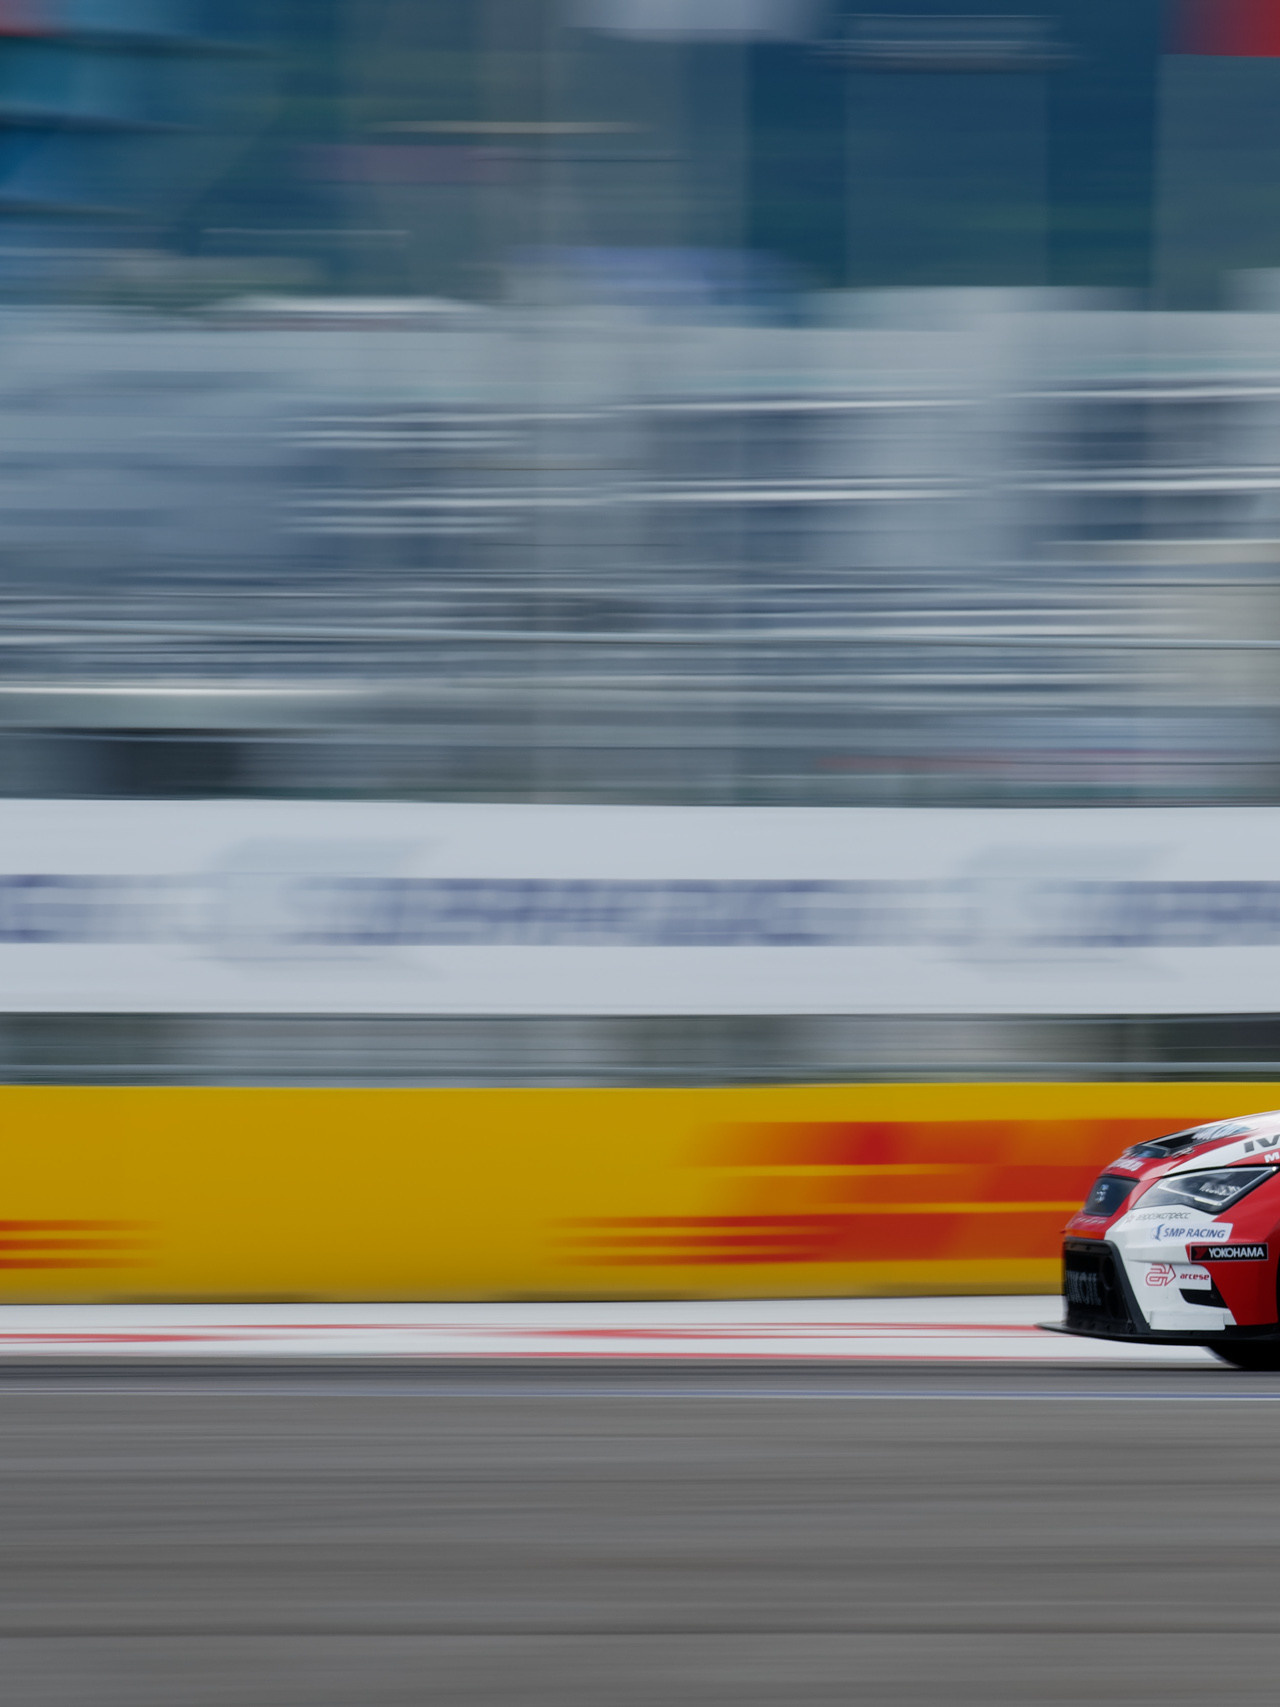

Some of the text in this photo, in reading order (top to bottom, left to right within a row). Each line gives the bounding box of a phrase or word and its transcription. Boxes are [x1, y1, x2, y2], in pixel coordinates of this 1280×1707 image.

[1164, 1228, 1226, 1238] SMP RACING
[1208, 1247, 1265, 1258] YOKOHAMA
[1180, 1273, 1210, 1281] arcese
